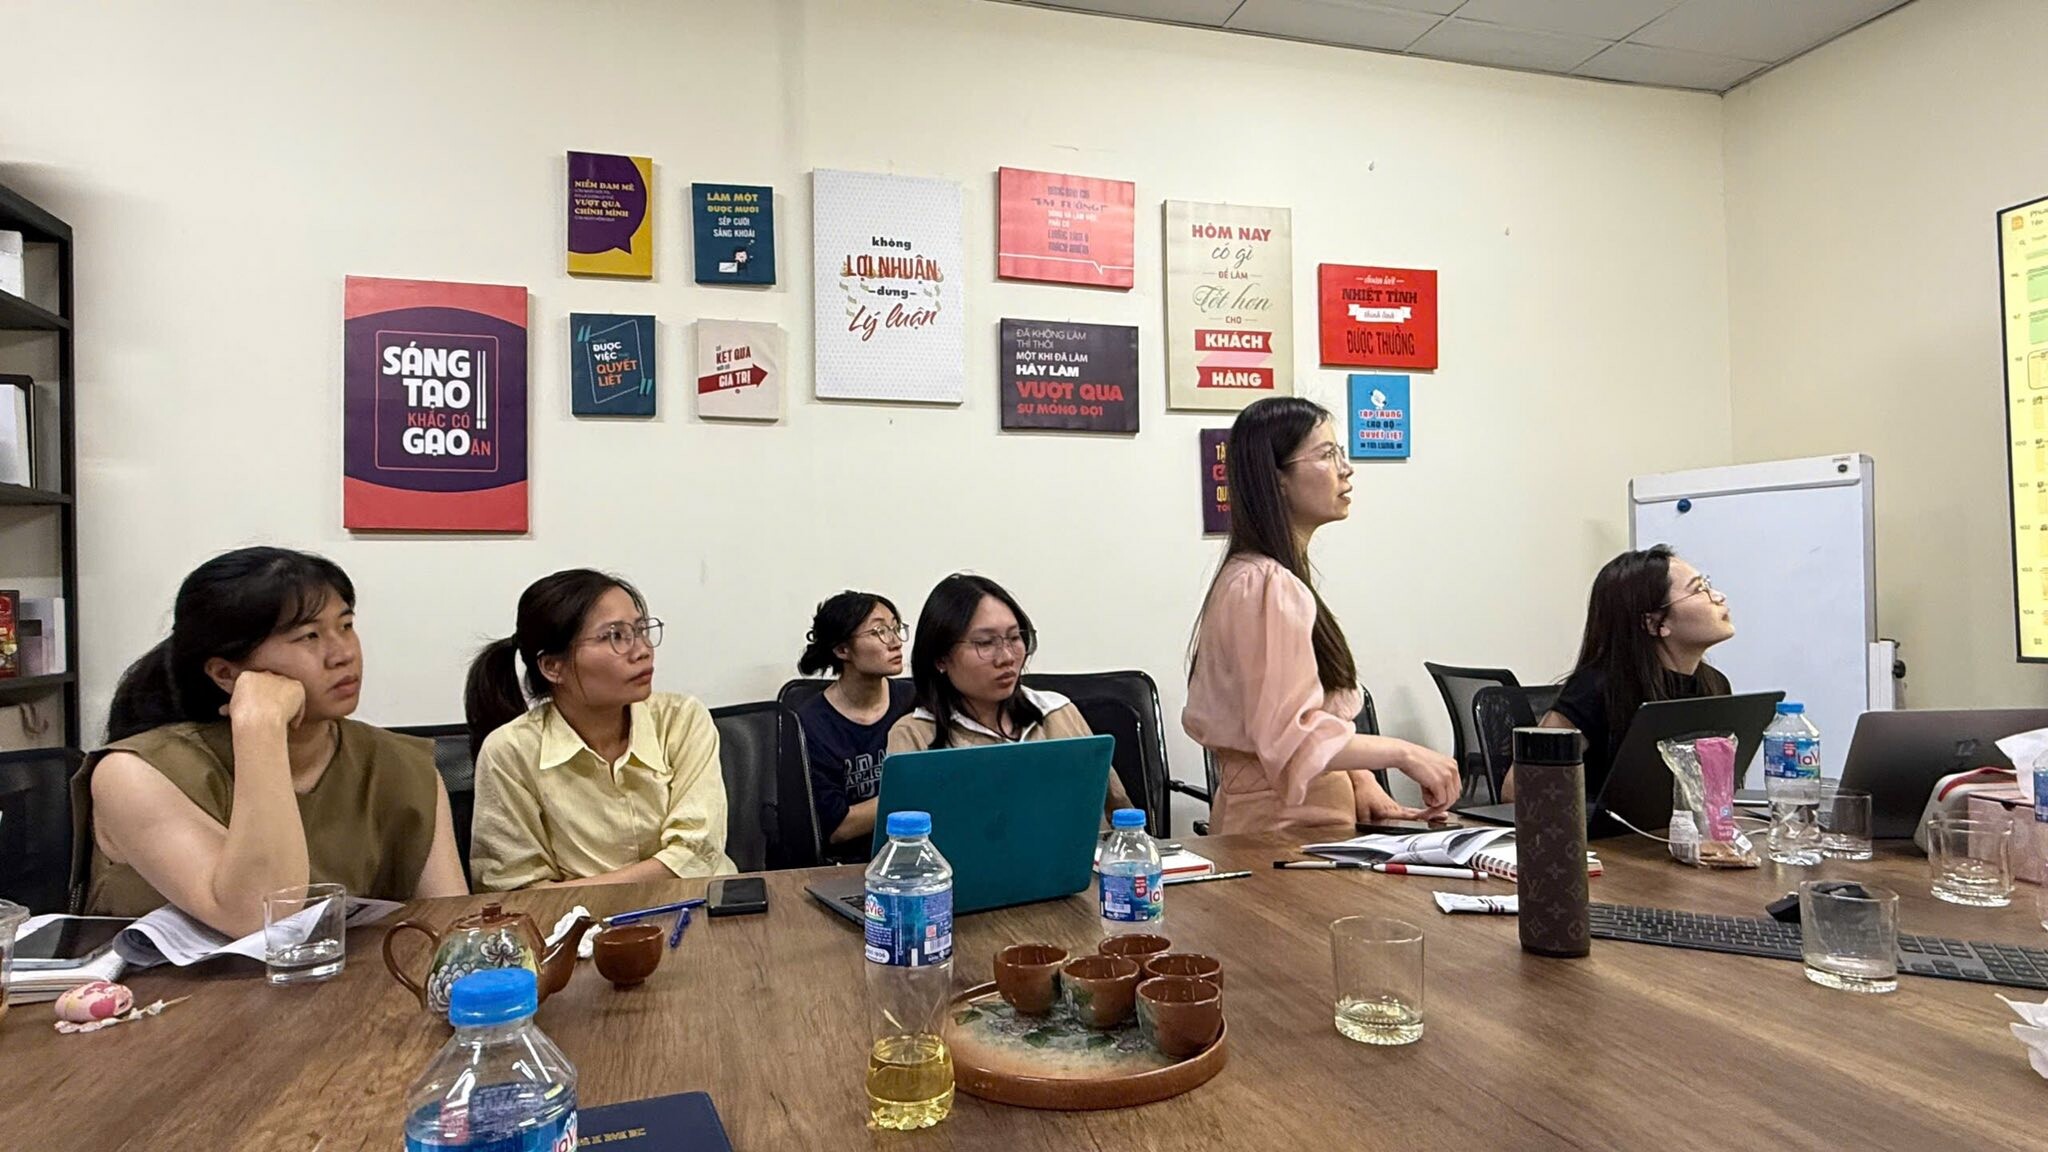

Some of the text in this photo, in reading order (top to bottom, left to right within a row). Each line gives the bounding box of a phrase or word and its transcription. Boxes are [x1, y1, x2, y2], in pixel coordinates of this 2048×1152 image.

[601, 200, 622, 208] QUA
[1238, 227, 1272, 242] NAY
[1211, 243, 1232, 260] có
[1341, 287, 1418, 305] NHIỆT TÌNH
[848, 305, 881, 342] Lý
[1225, 315, 1243, 325] CHO
[1204, 331, 1264, 349] KHÁCH
[382, 341, 471, 378] SÁNG
[1038, 352, 1054, 361] KHI
[1211, 370, 1263, 387] HÀNG
[402, 378, 471, 409] TẠO
[1079, 383, 1125, 401] QUA
[402, 427, 471, 456] GẠO
